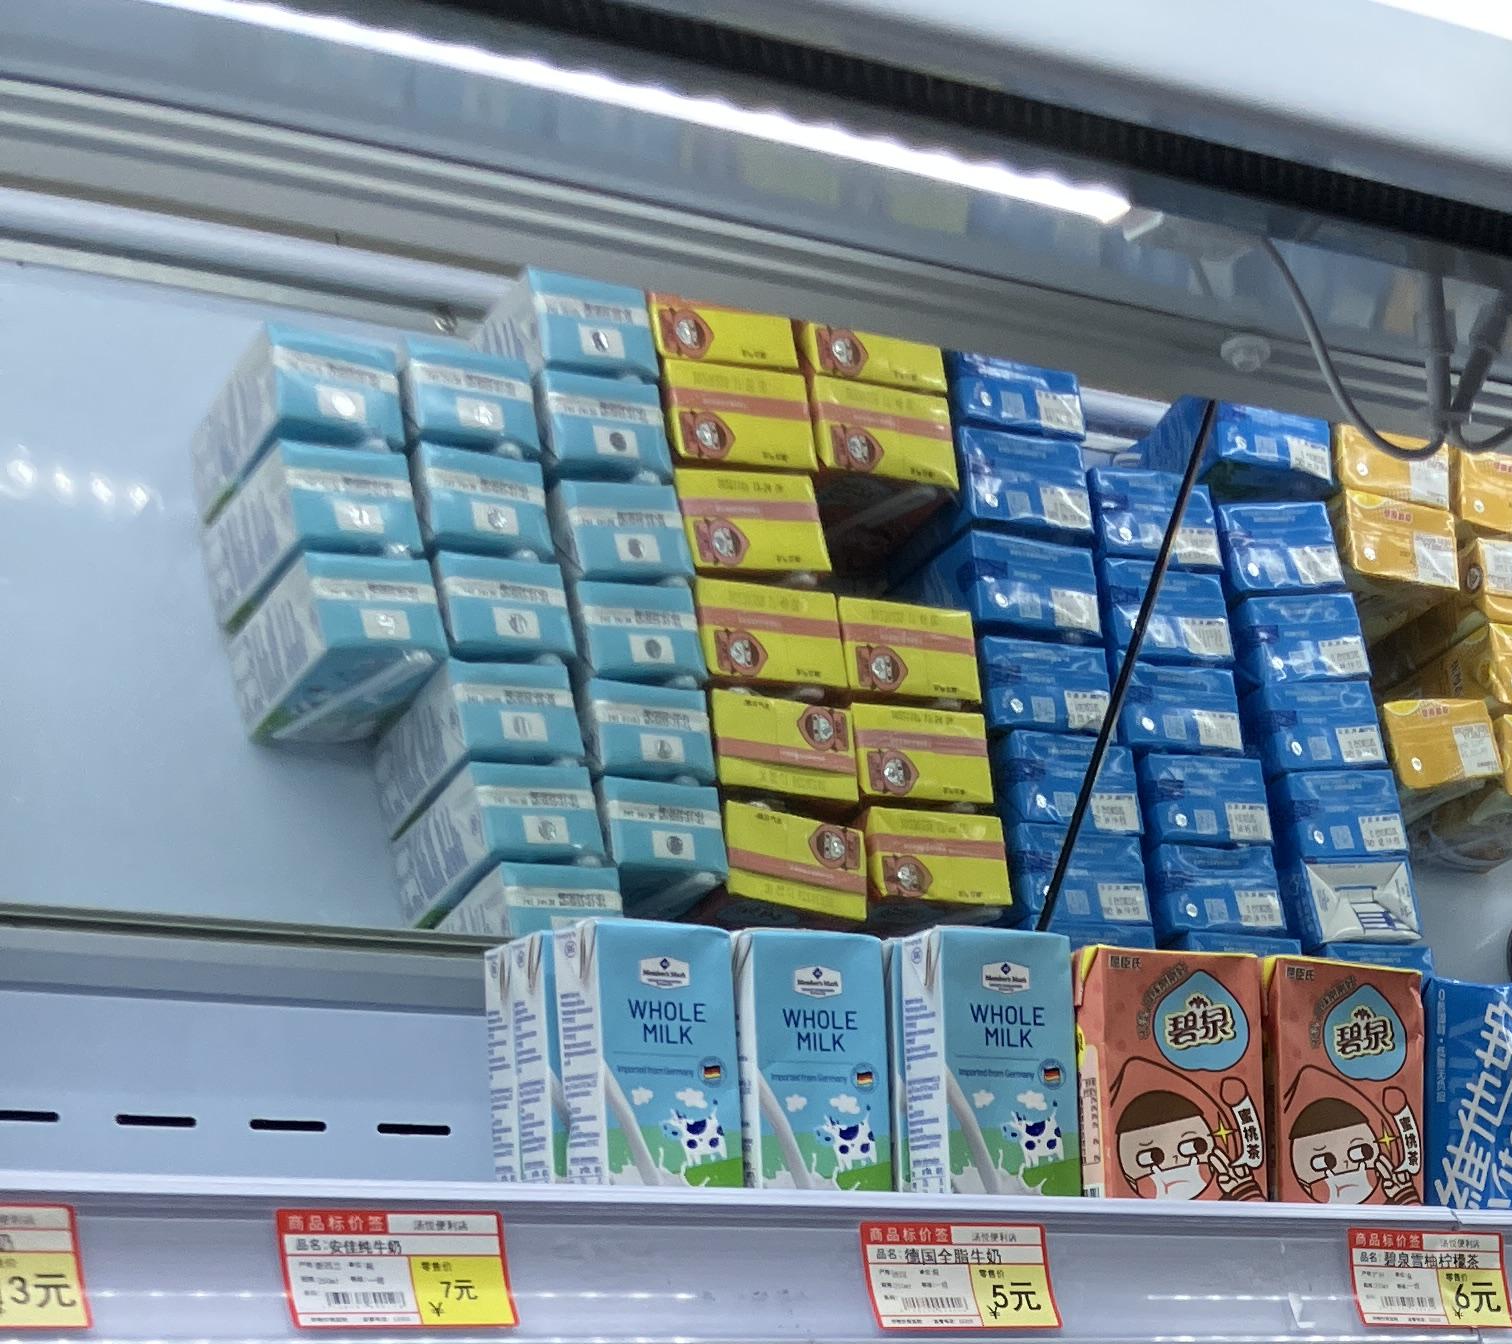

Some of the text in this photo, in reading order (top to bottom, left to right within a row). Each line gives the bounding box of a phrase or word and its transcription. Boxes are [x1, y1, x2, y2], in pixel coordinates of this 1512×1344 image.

[627, 998, 707, 1023] WHOLE
[782, 1007, 859, 1031] WHOLE
[970, 1003, 1045, 1027] WHOLE
[642, 1021, 694, 1045] MILK
[984, 1027, 1034, 1049] MILK
[1166, 1004, 1237, 1050] 碧泉
[1336, 1016, 1396, 1058] 碧泉
[797, 1031, 846, 1053] MILK
[1236, 1106, 1262, 1162] 蜜桃茶
[1397, 1112, 1422, 1170] 蜜桃茶
[287, 1215, 386, 1232] 商品标价签
[869, 1227, 949, 1243] 商品标价签
[1355, 1233, 1421, 1249] 商品标价签
[440, 1279, 479, 1301] 7元
[992, 1282, 1042, 1311] 5元
[1455, 1282, 1502, 1313] 6元
